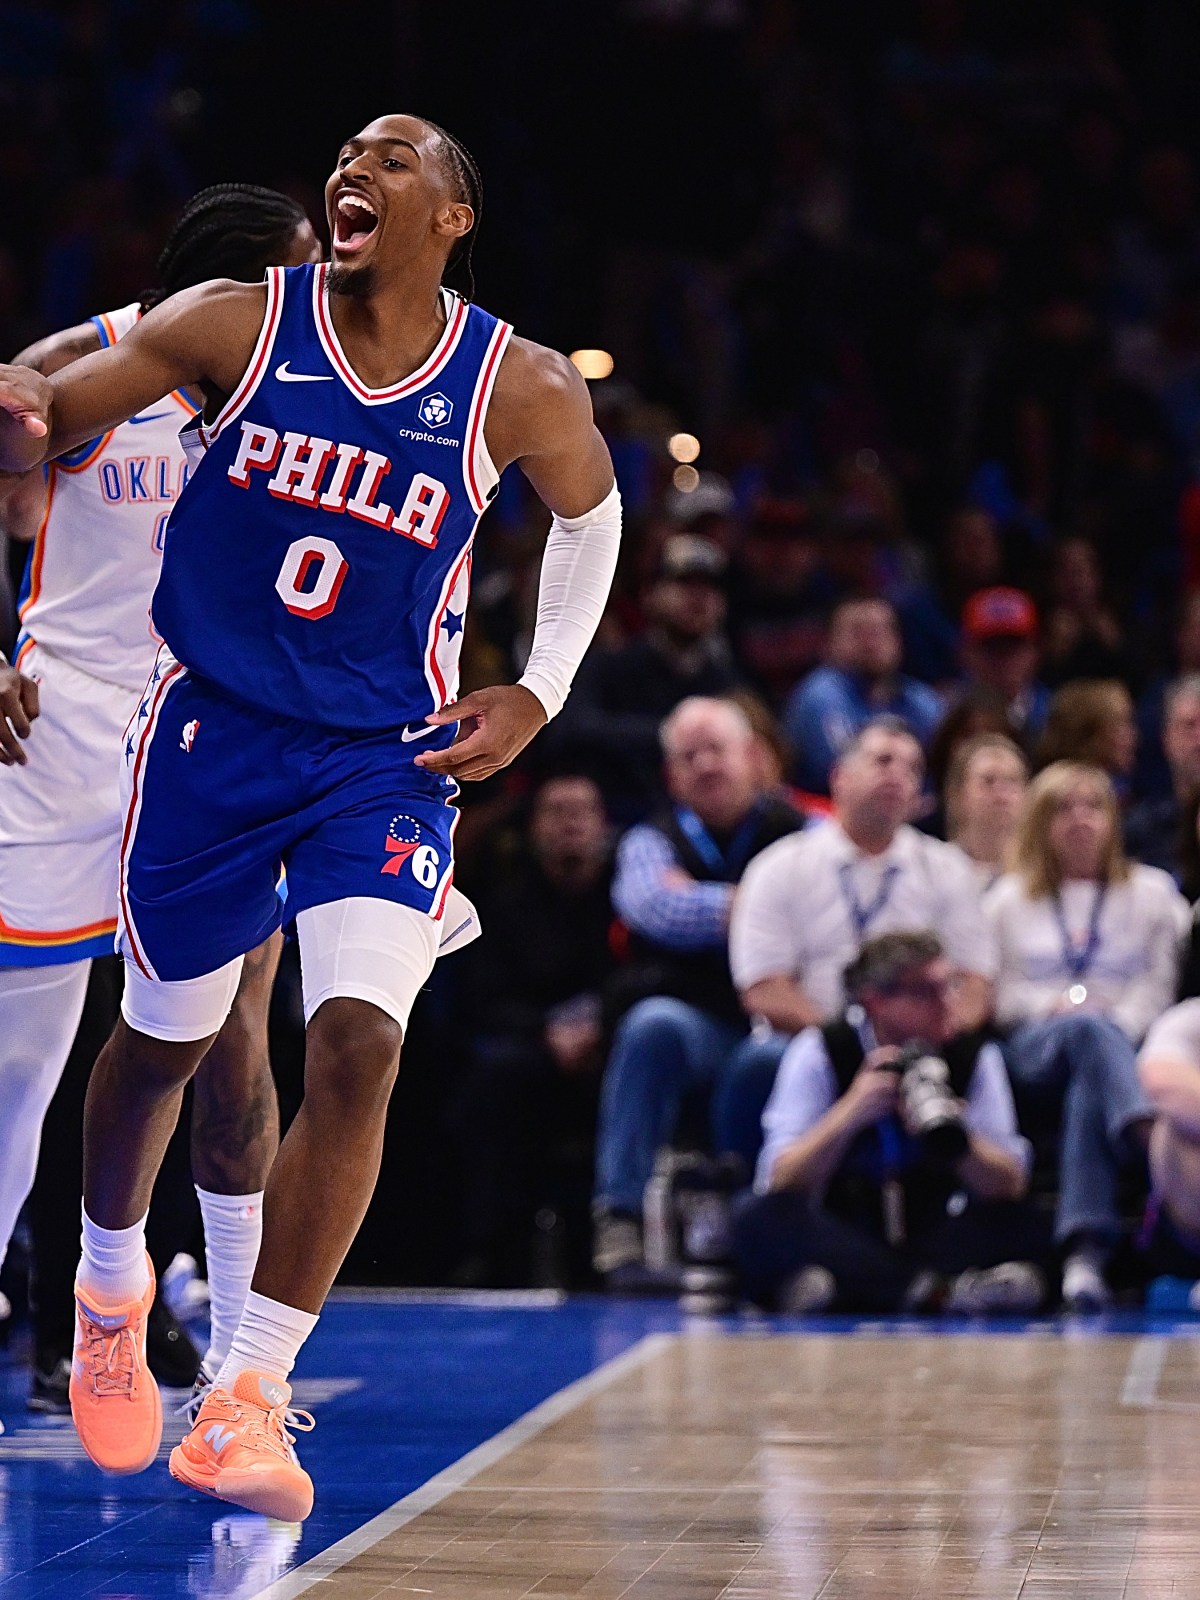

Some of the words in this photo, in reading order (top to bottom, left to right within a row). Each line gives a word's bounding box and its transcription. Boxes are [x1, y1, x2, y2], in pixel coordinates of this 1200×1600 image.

[399, 429, 460, 448] crypto.com
[227, 420, 450, 549] PHILA
[275, 535, 349, 621] 0
[380, 834, 440, 890] 76
